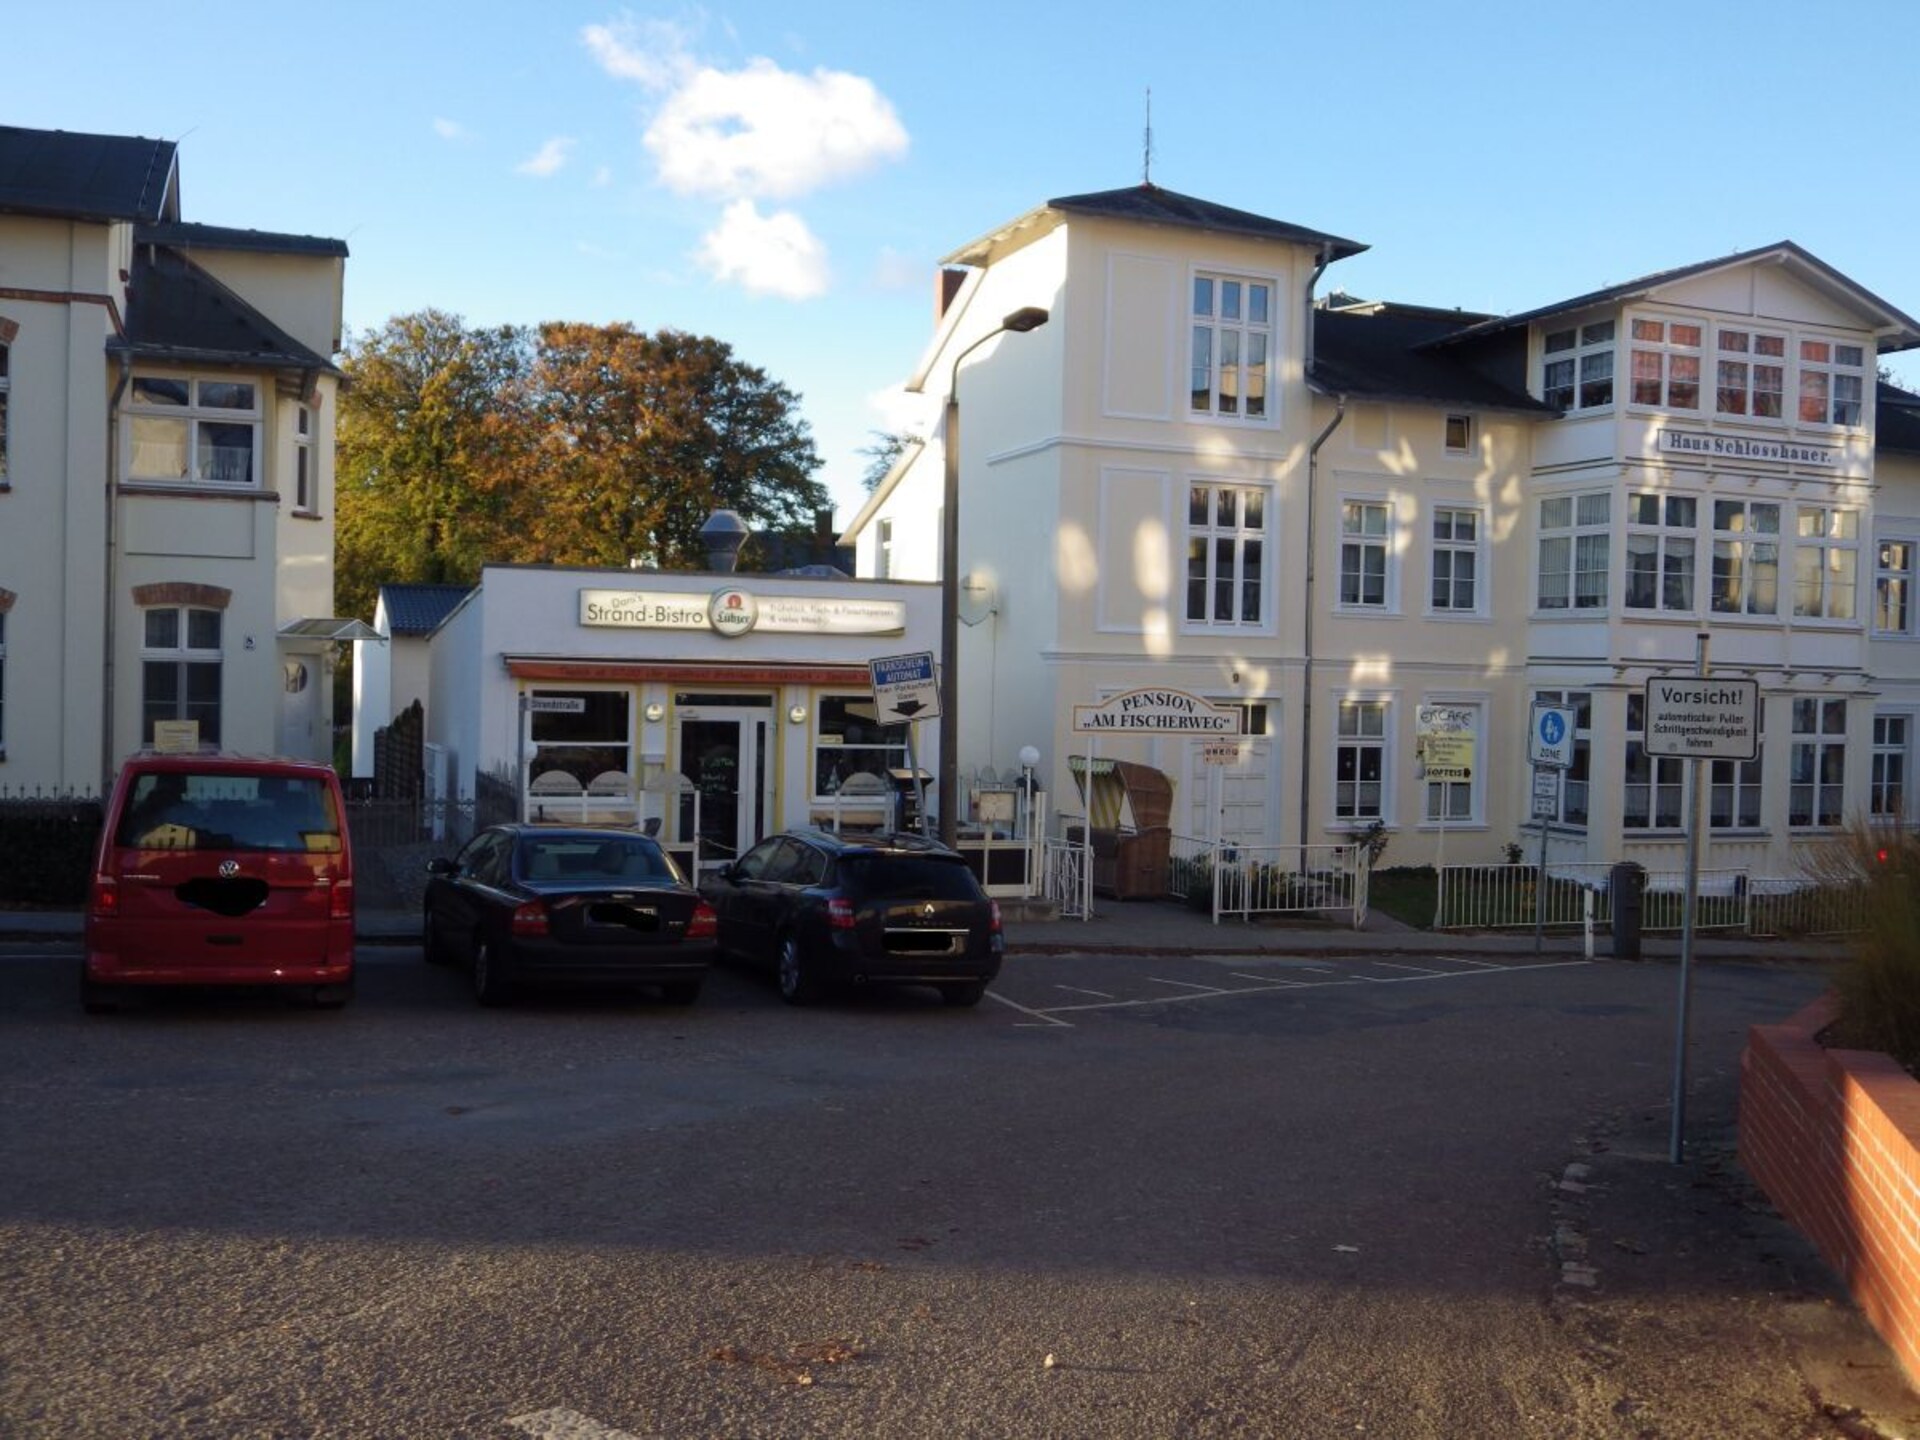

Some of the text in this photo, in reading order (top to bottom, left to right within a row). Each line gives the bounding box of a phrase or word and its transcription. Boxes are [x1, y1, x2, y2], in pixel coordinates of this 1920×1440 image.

[1670, 433, 1710, 450] Haus
[587, 603, 703, 623] Strand-Bistro
[886, 668, 921, 682] AUTOMAT
[1661, 686, 1744, 705] Vorsicht!
[1122, 692, 1197, 715] PENSION
[1657, 712, 1716, 722] automatischer
[1653, 724, 1748, 738] Schrittgeschwindigkeit
[1540, 747, 1561, 759] ZONE
